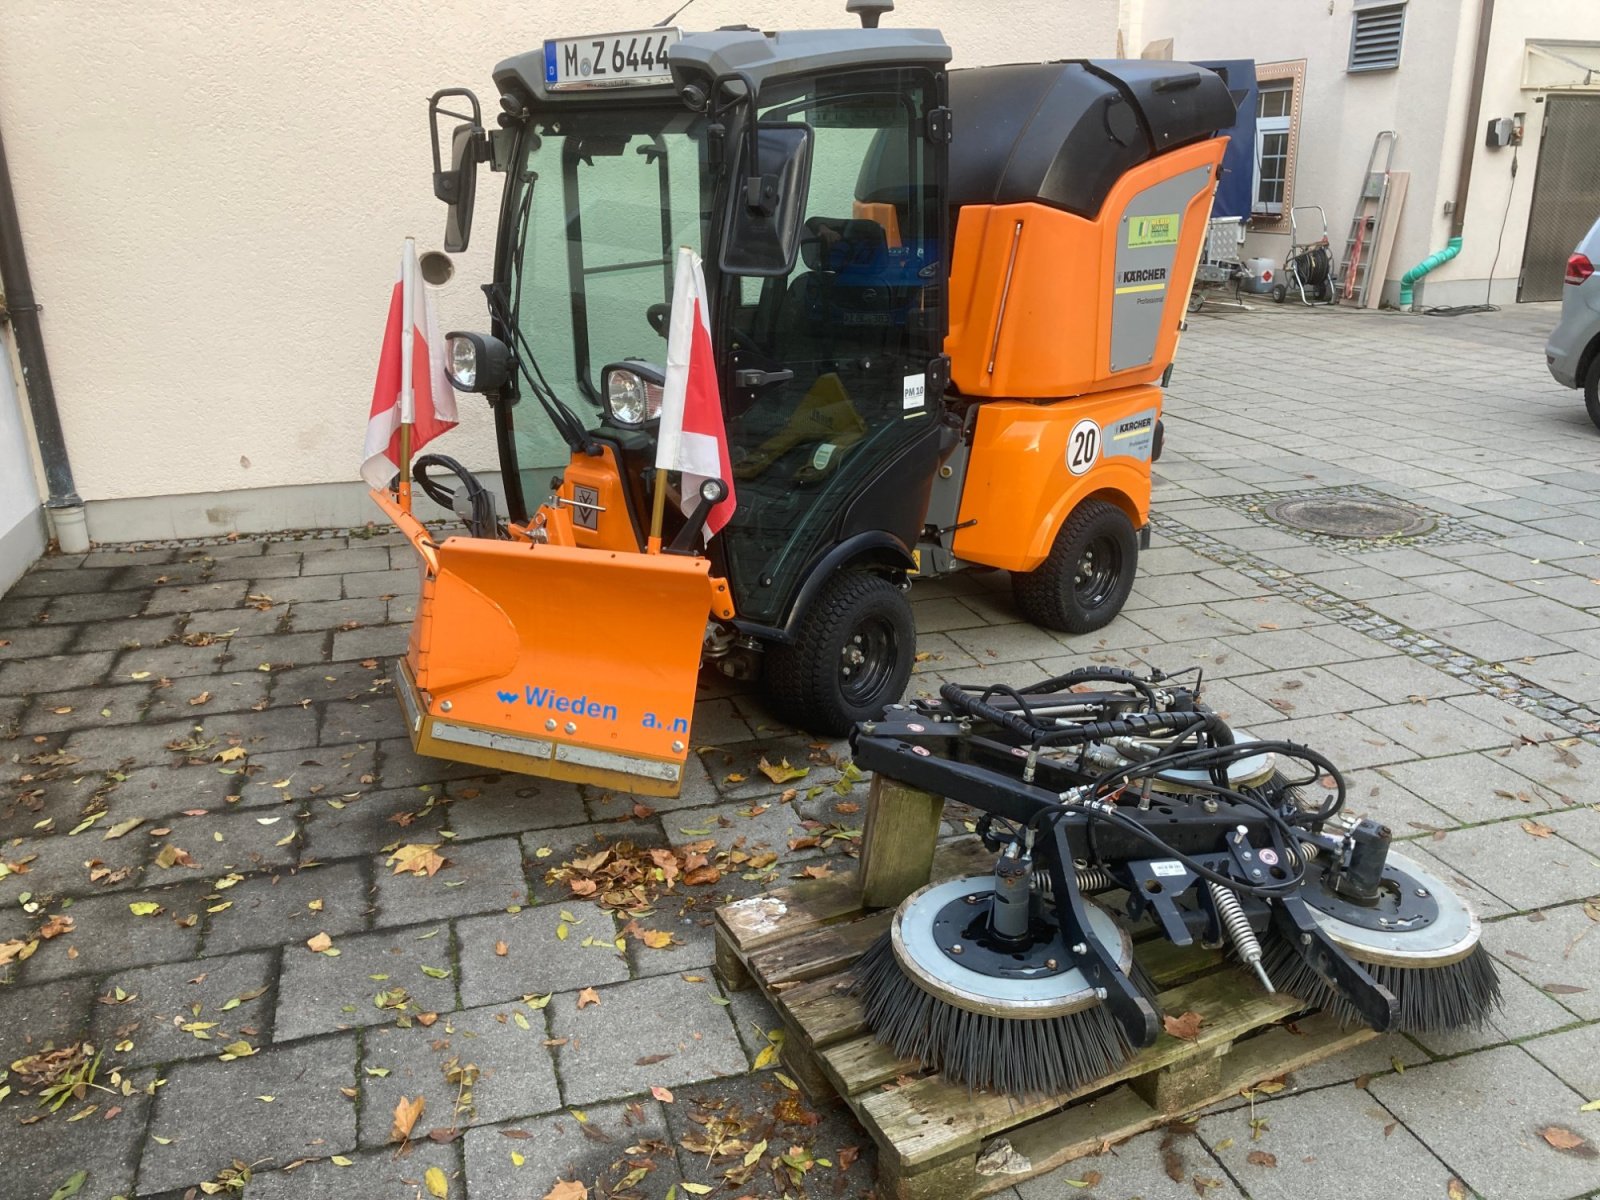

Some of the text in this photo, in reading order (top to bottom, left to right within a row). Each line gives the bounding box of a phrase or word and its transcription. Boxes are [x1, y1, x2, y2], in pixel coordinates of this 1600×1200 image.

[564, 43, 579, 77] M
[592, 41, 607, 75] Z
[612, 35, 670, 73] 6444
[1123, 267, 1166, 283] KÄRCHER
[904, 387, 916, 398] PM
[916, 385, 924, 395] 10
[1119, 417, 1152, 433] KÄRCHER
[1072, 428, 1096, 467] 20
